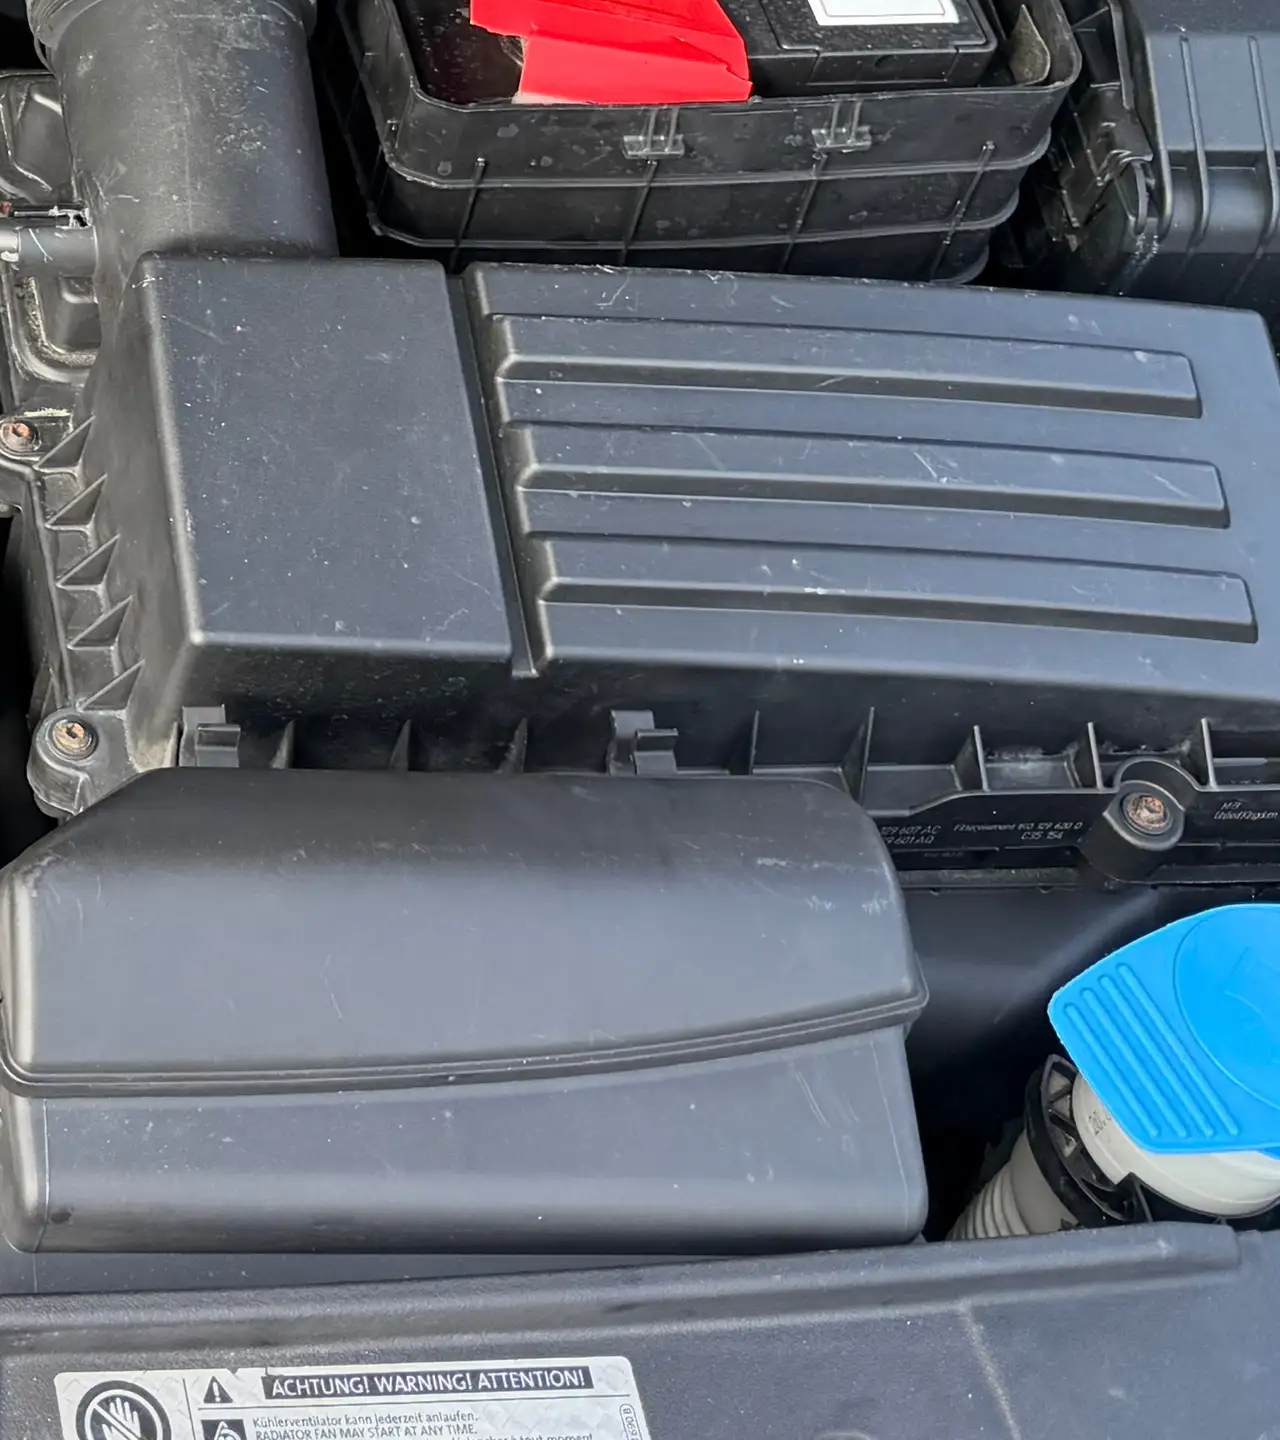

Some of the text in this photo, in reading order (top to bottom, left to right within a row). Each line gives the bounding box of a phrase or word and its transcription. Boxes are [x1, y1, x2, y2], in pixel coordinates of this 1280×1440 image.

[272, 1369, 585, 1397] ACHTUNG! WARNING! ATTENTION!
[252, 1410, 479, 1428] Kühlerventilator kann jederzeit anlaufen.
[256, 1423, 478, 1440] RADIATOR FAN MAY START AT ANY TIME.
